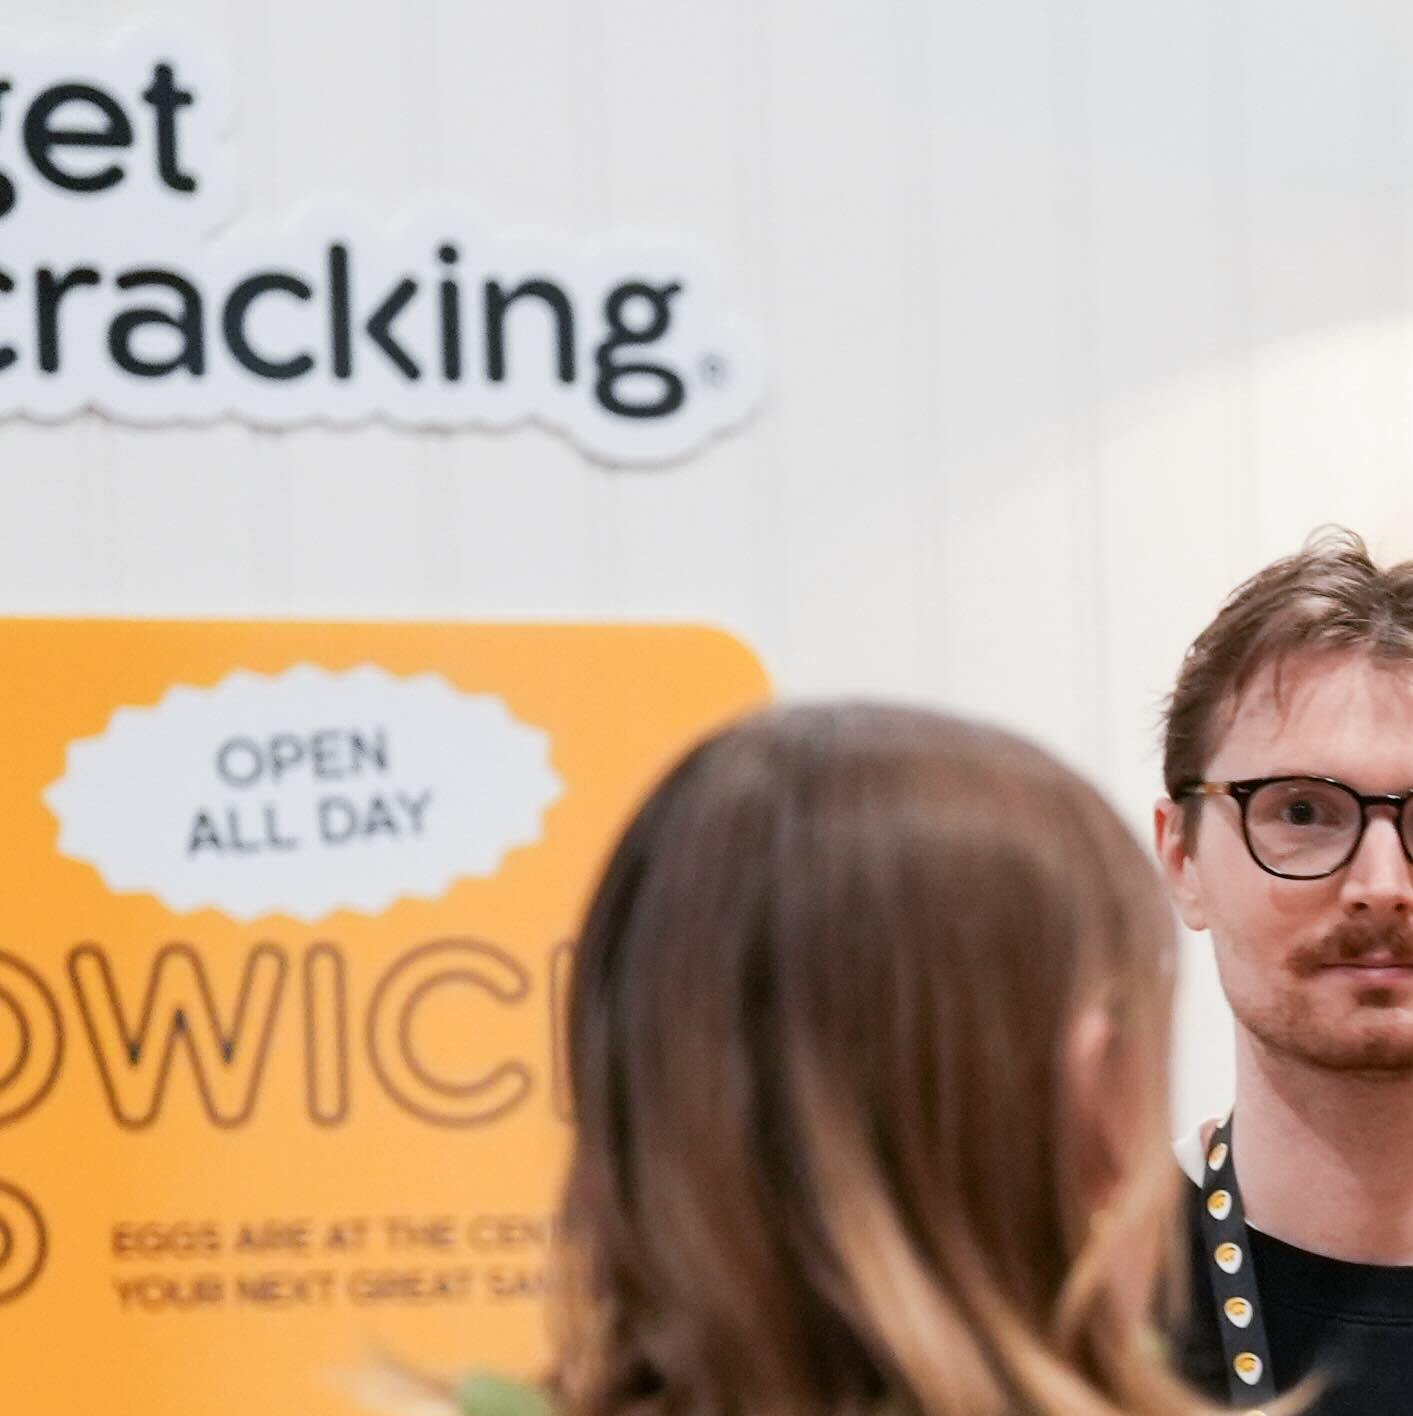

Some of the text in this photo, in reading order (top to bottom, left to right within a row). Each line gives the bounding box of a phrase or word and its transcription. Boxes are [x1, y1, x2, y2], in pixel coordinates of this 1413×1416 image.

[0, 62, 196, 218] et
[0, 243, 686, 418] racking
[217, 728, 388, 788] OPEN
[184, 791, 432, 857] ALL DAY
[0, 938, 578, 1132] WIC
[112, 1219, 220, 1259] EGGS
[235, 1217, 308, 1252] ARE
[324, 1216, 366, 1252] AT
[384, 1215, 455, 1251] THE
[112, 1272, 223, 1312] YOUR
[237, 1270, 335, 1308] NEXT
